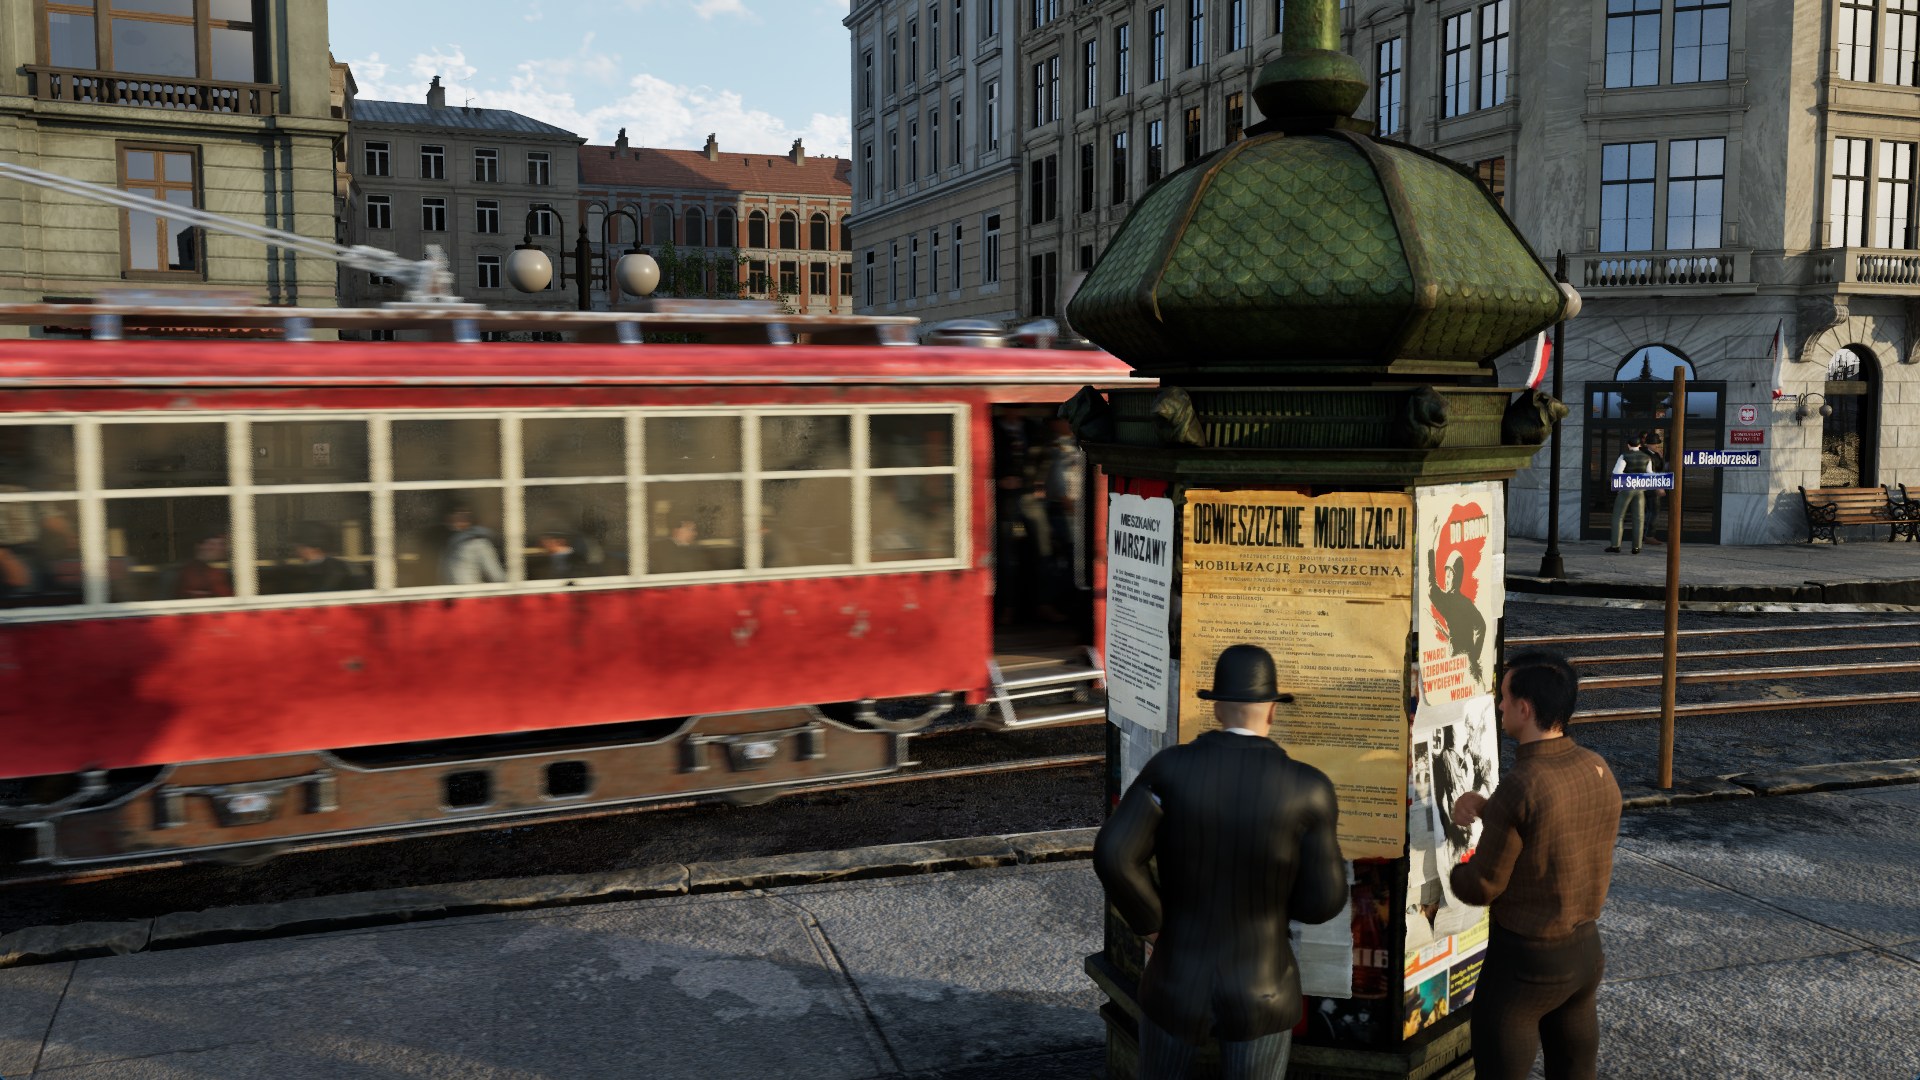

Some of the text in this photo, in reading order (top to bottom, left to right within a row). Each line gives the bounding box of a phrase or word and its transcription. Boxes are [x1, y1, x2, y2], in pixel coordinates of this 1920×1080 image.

[1684, 451, 1757, 466] ul. Białobrzeska
[1613, 475, 1671, 490] ul. Sękocińska
[1194, 503, 1407, 550] OBWIESZCZENIE MOBILIZACJI
[1450, 520, 1462, 545] DO
[1114, 530, 1167, 567] WARSZAWY
[1194, 560, 1404, 577] MOBILIZACJĘ POWSZECHNĄ.
[1423, 647, 1447, 663] ZWARCI
